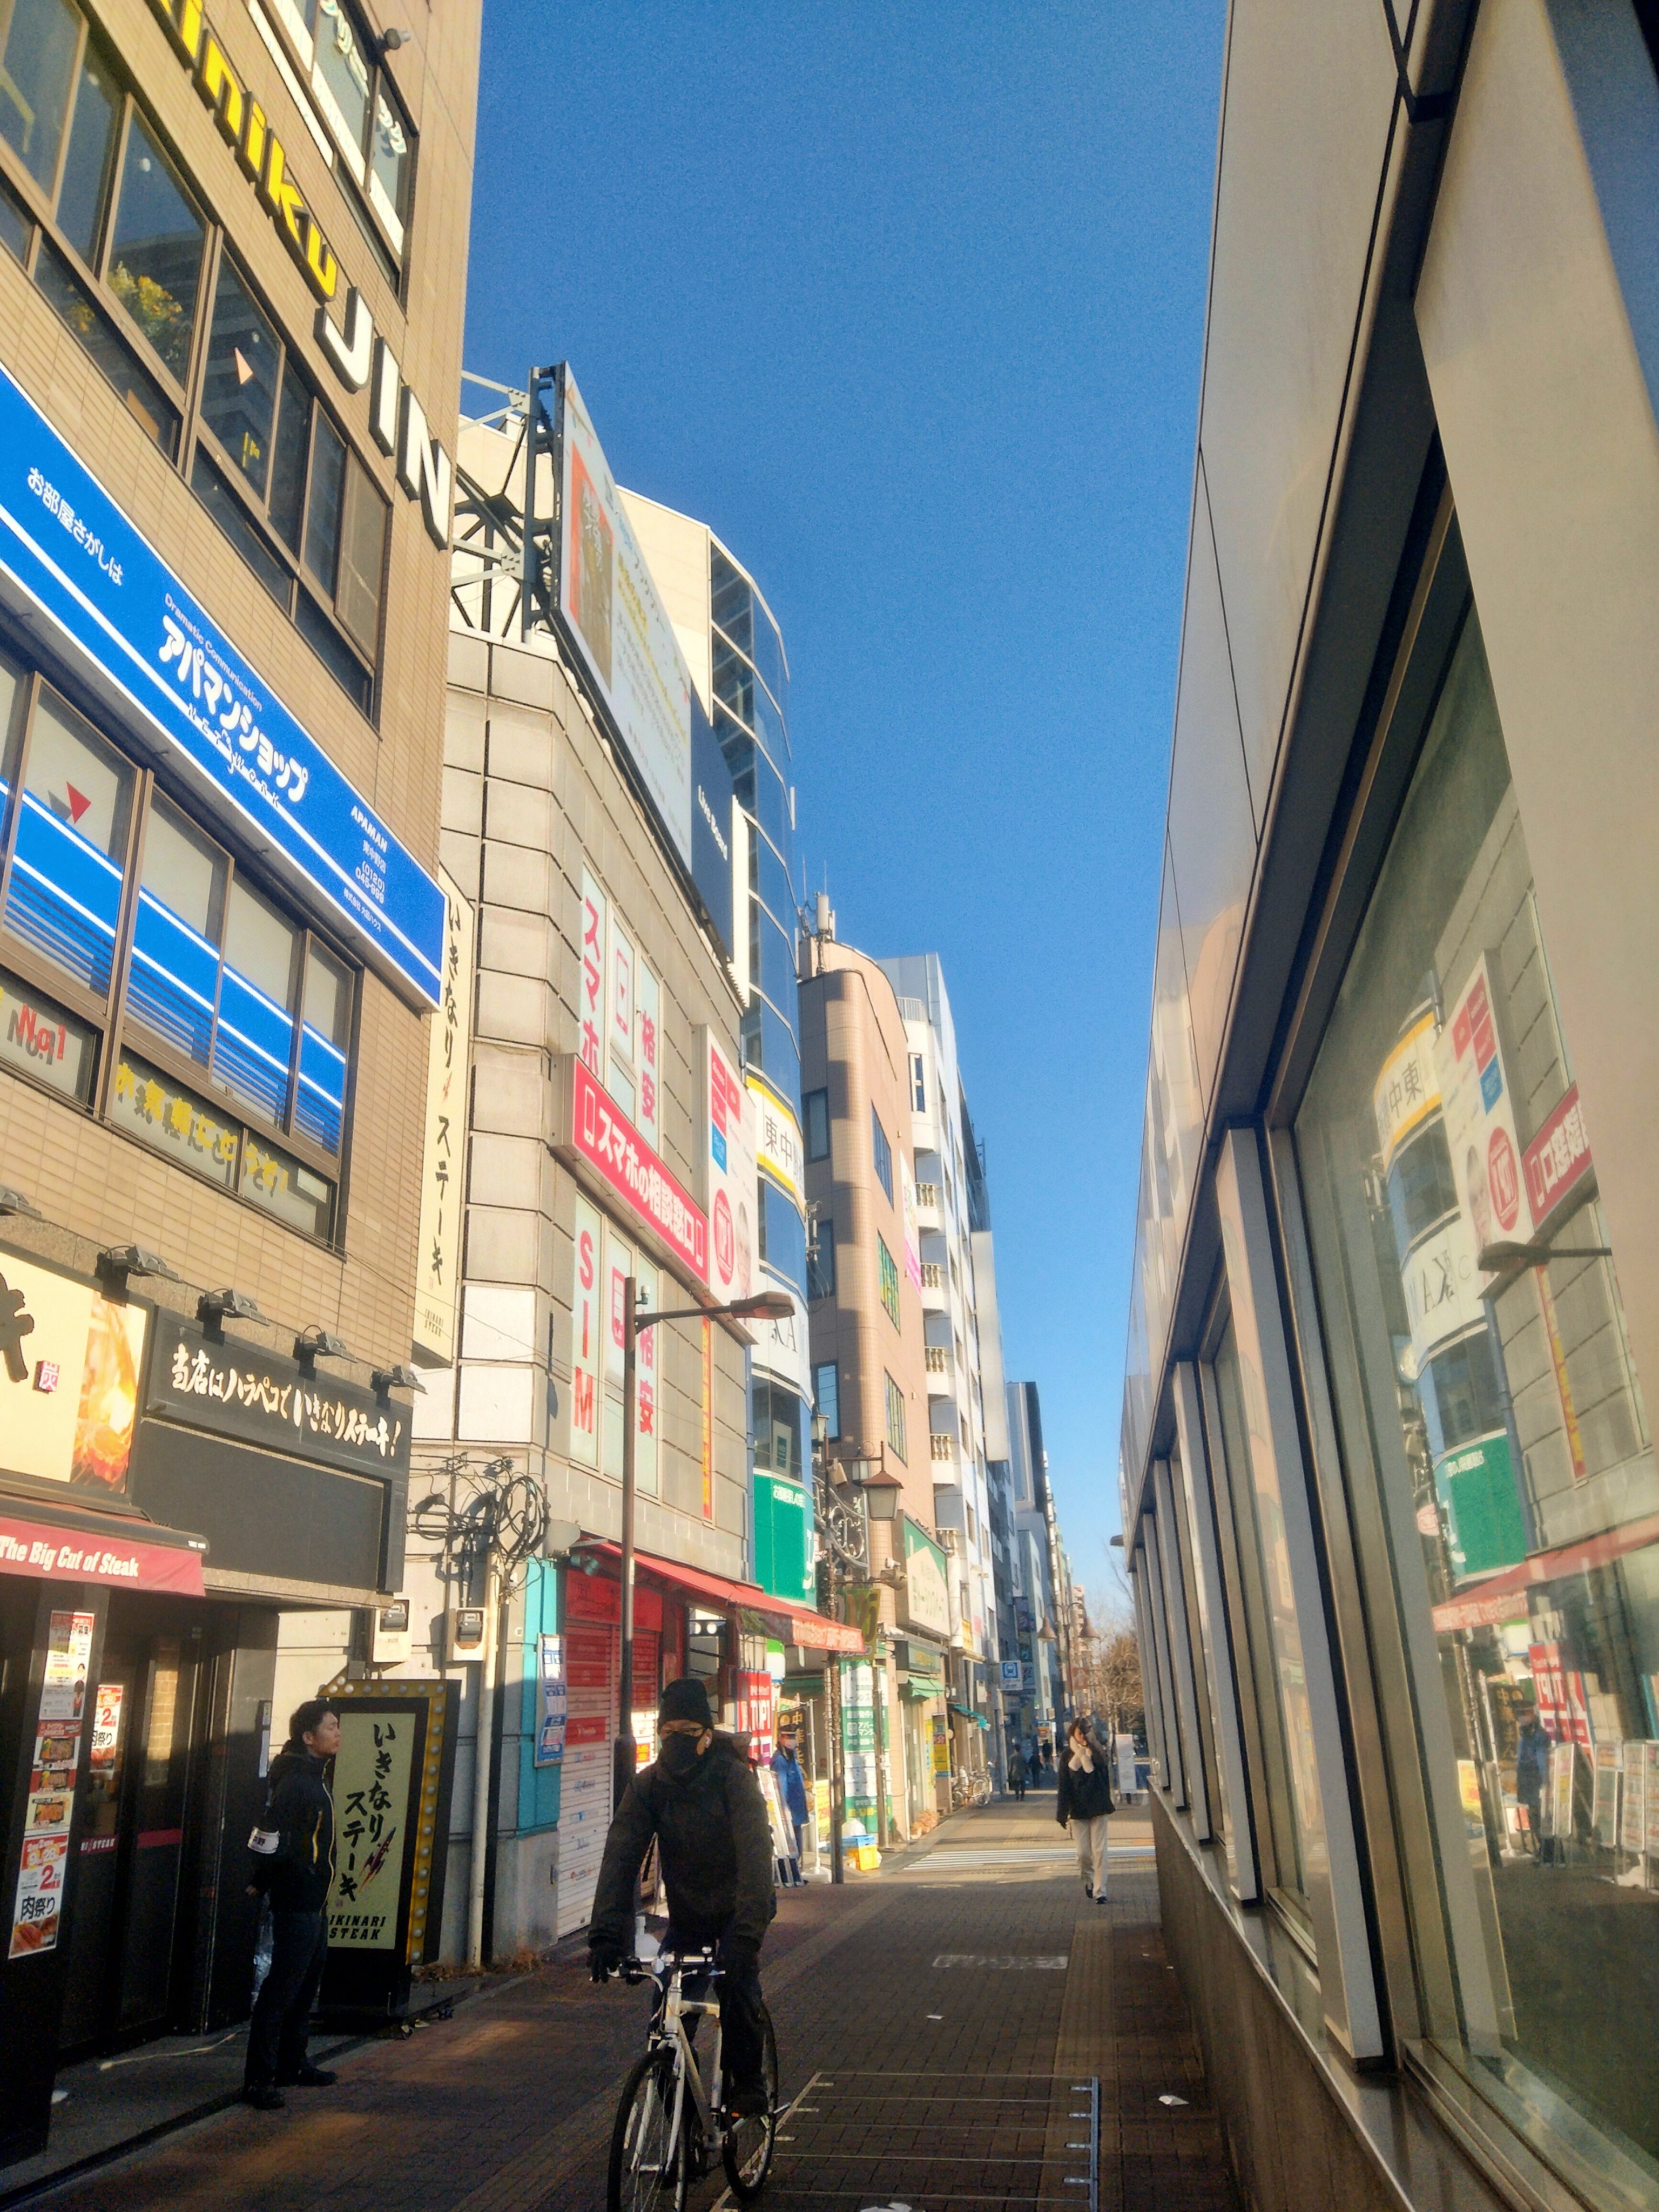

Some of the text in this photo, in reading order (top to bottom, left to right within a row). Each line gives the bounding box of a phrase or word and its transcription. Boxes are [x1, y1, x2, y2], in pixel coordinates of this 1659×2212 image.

[162, 0, 338, 298] iniku
[320, 289, 451, 549] JIN
[27, 467, 124, 585] お部屋さがしは
[158, 614, 309, 802] アパマンショップ
[164, 592, 263, 712] Dramatic Communication
[350, 805, 388, 853] APAMAN
[362, 860, 385, 893] (0120)
[582, 894, 601, 1078] スマホ
[641, 1009, 656, 1125] 格安
[597, 1106, 695, 1257] スマホの相談窓口
[38, 1360, 60, 1392] 炭
[171, 1342, 292, 1420] 当店はハラペコで
[574, 1229, 594, 1435] SIM
[0, 1534, 139, 1578] The Big Cut of Steak
[368, 1723, 396, 1846] いきなり
[339, 1790, 368, 1902] ステーキ
[20, 1895, 56, 1921] 肉祭り
[329, 1914, 387, 1928] IKINARI
[329, 1927, 381, 1941] STEAK
